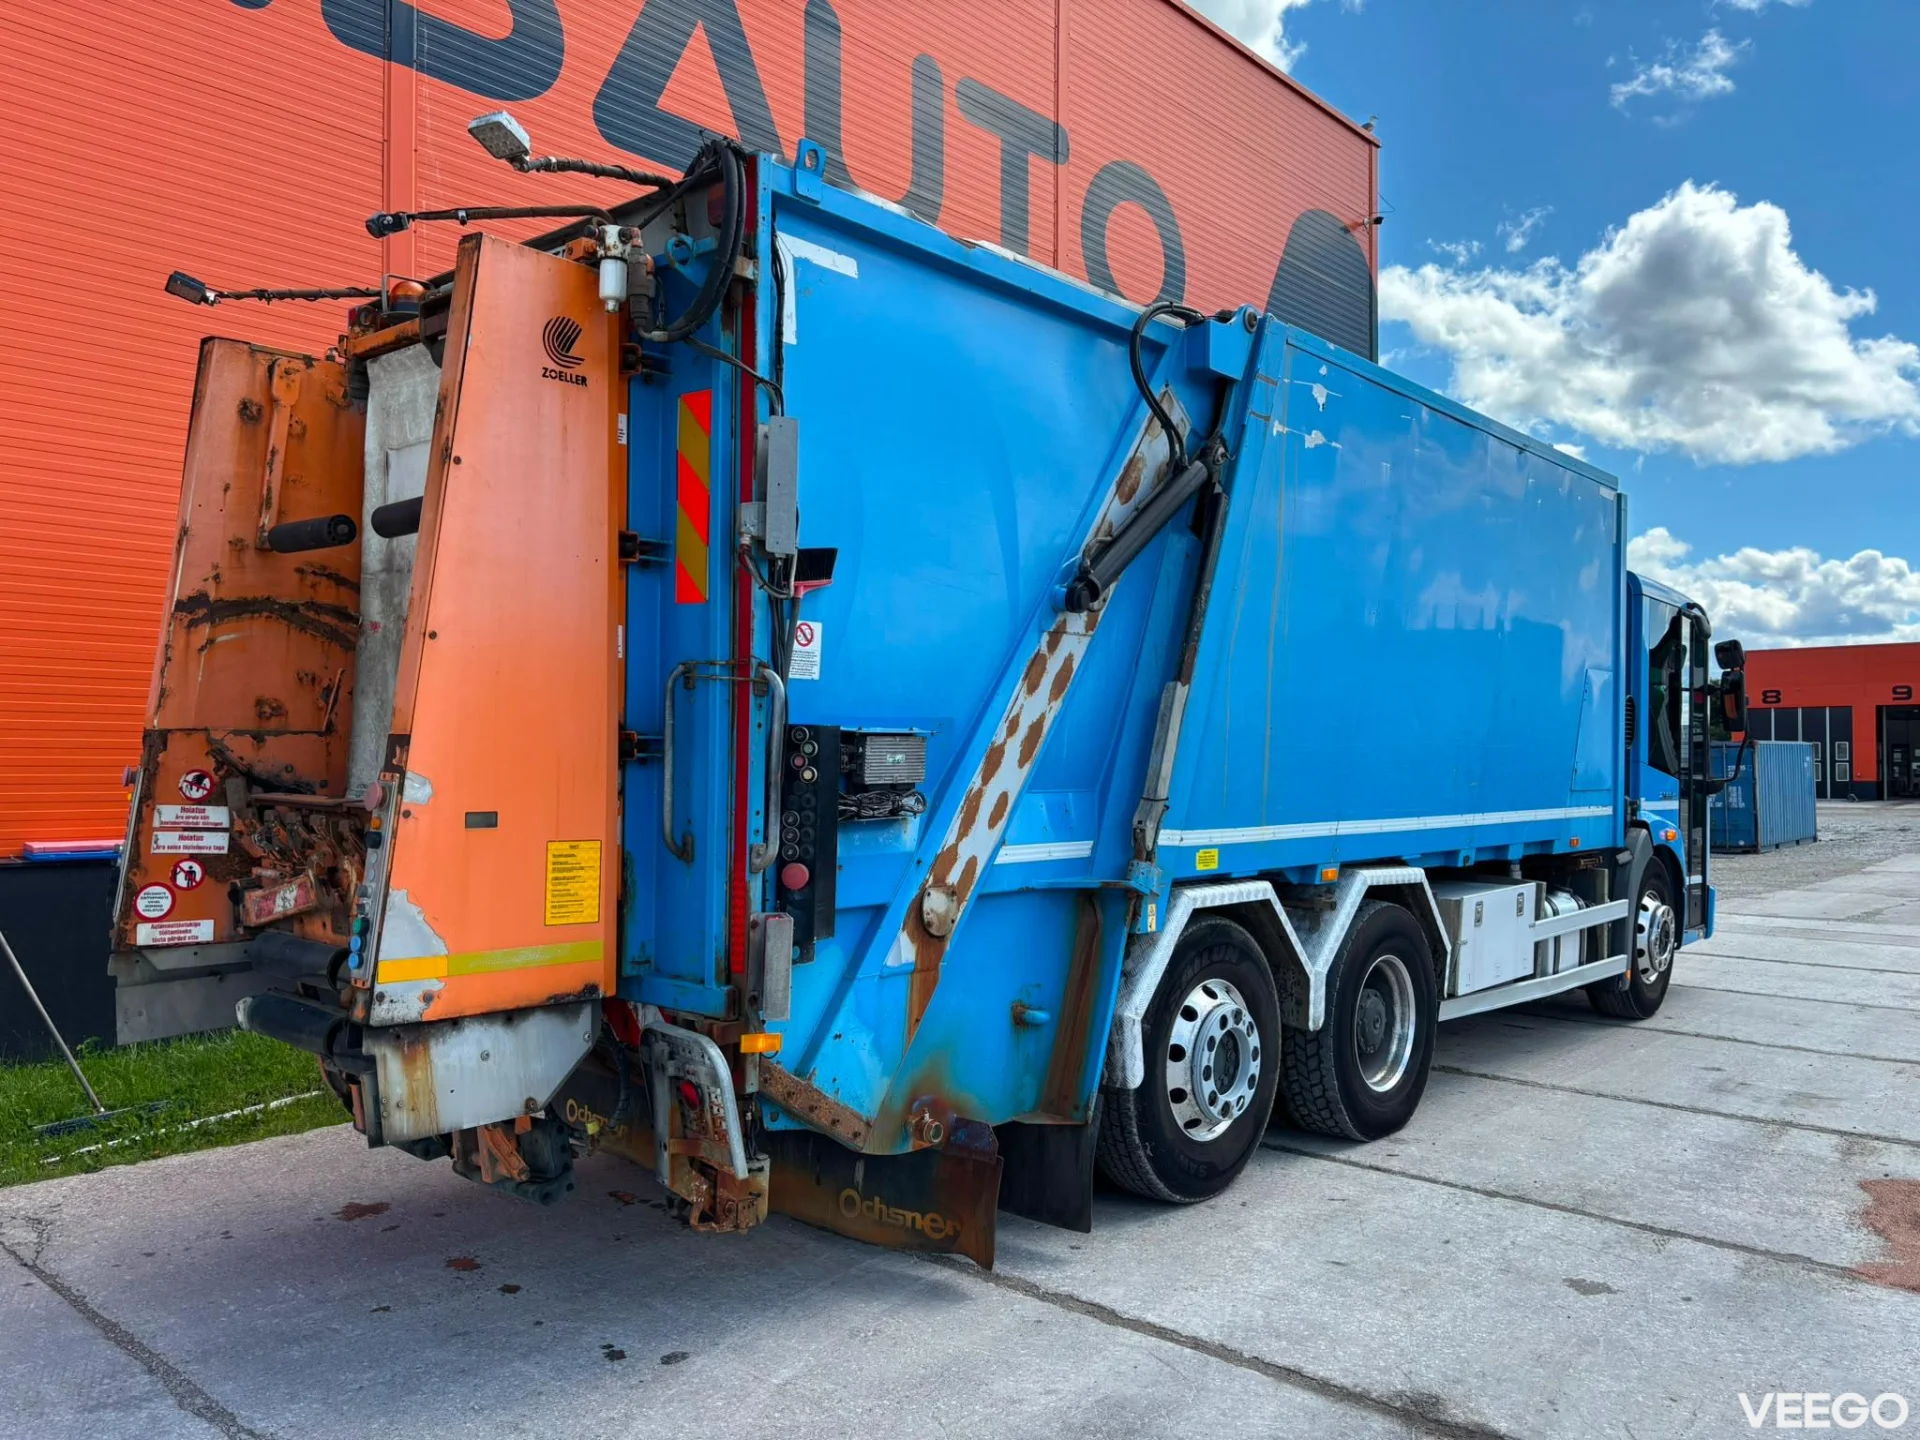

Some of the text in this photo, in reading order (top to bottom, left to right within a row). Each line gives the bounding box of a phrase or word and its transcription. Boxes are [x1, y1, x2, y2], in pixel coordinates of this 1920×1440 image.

[541, 366, 588, 387] ZOELLER
[1761, 689, 1782, 704] 8
[1892, 685, 1913, 701] 9
[839, 1187, 962, 1239] Ochsner
